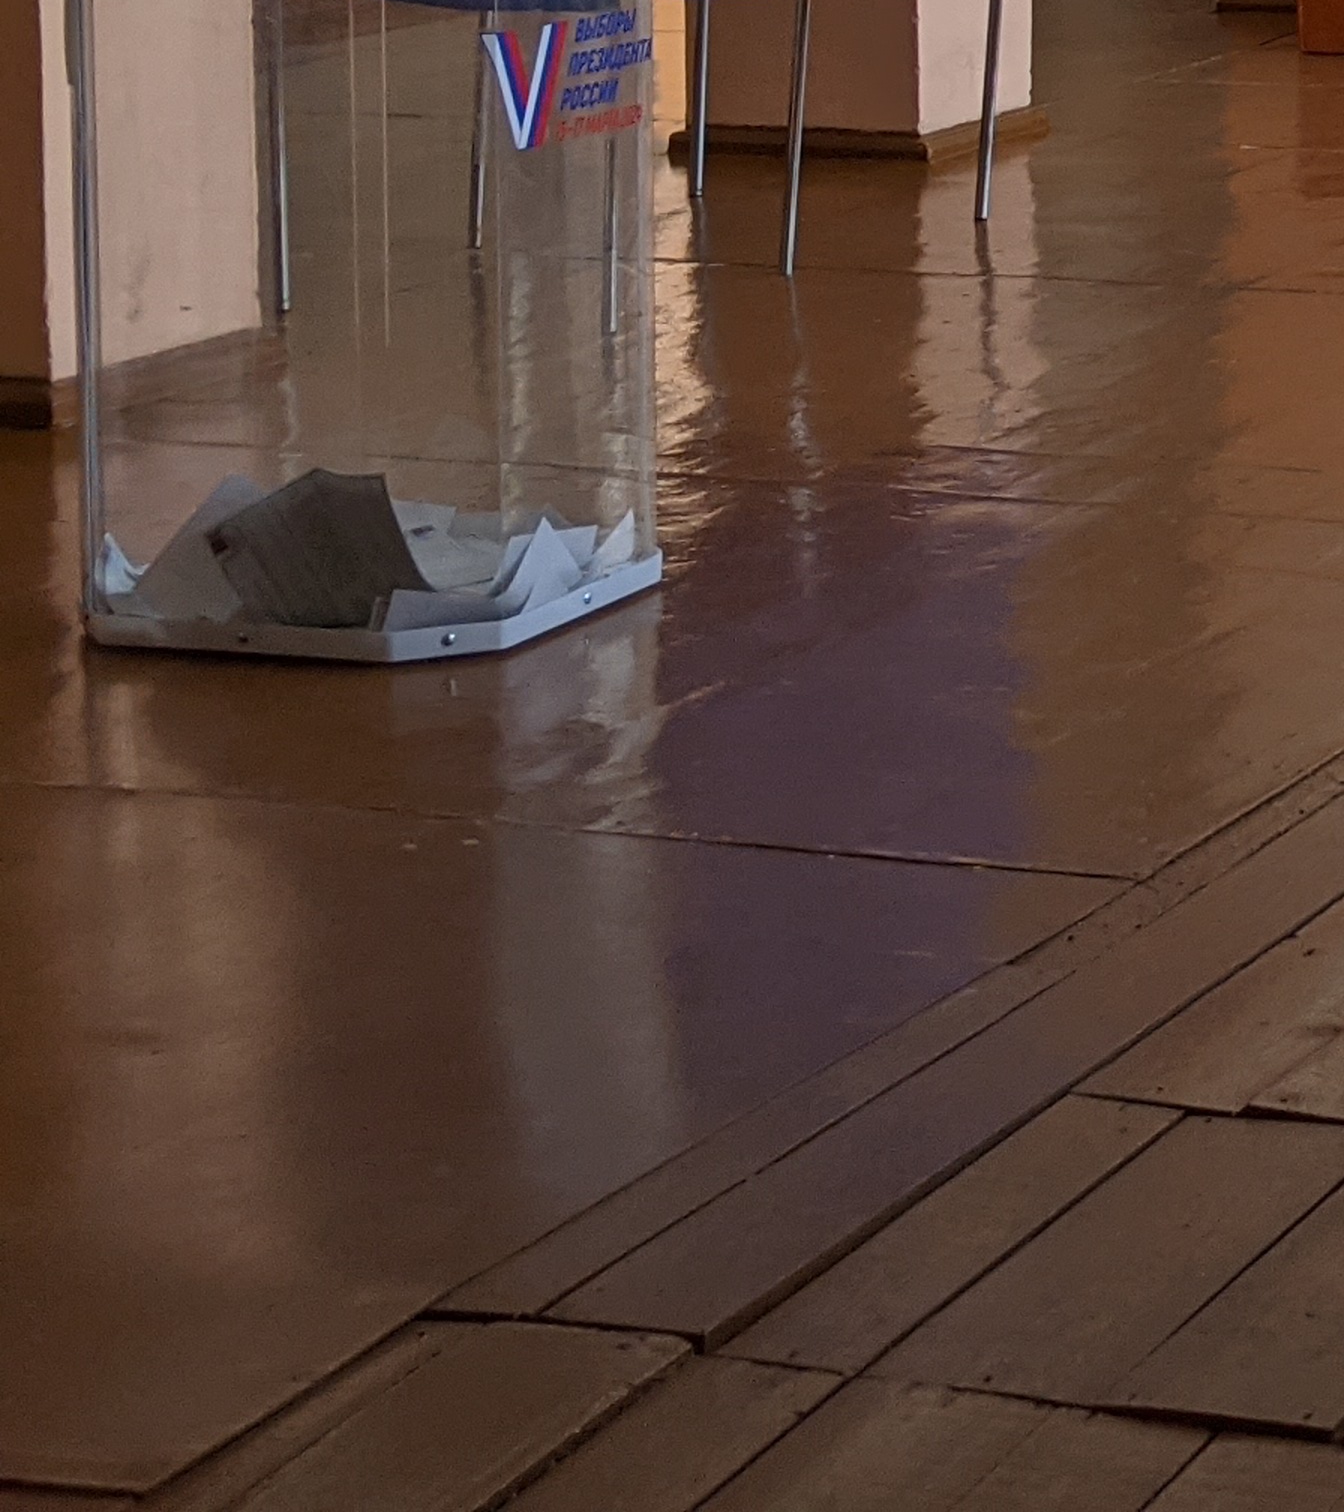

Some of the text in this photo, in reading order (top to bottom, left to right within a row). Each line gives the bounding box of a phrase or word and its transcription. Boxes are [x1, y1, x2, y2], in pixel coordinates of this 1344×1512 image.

[575, 9, 636, 42] ВЫБОРЫ
[568, 38, 652, 76] ПРЕЗИДЕНТА
[561, 78, 618, 110] РОССИИ
